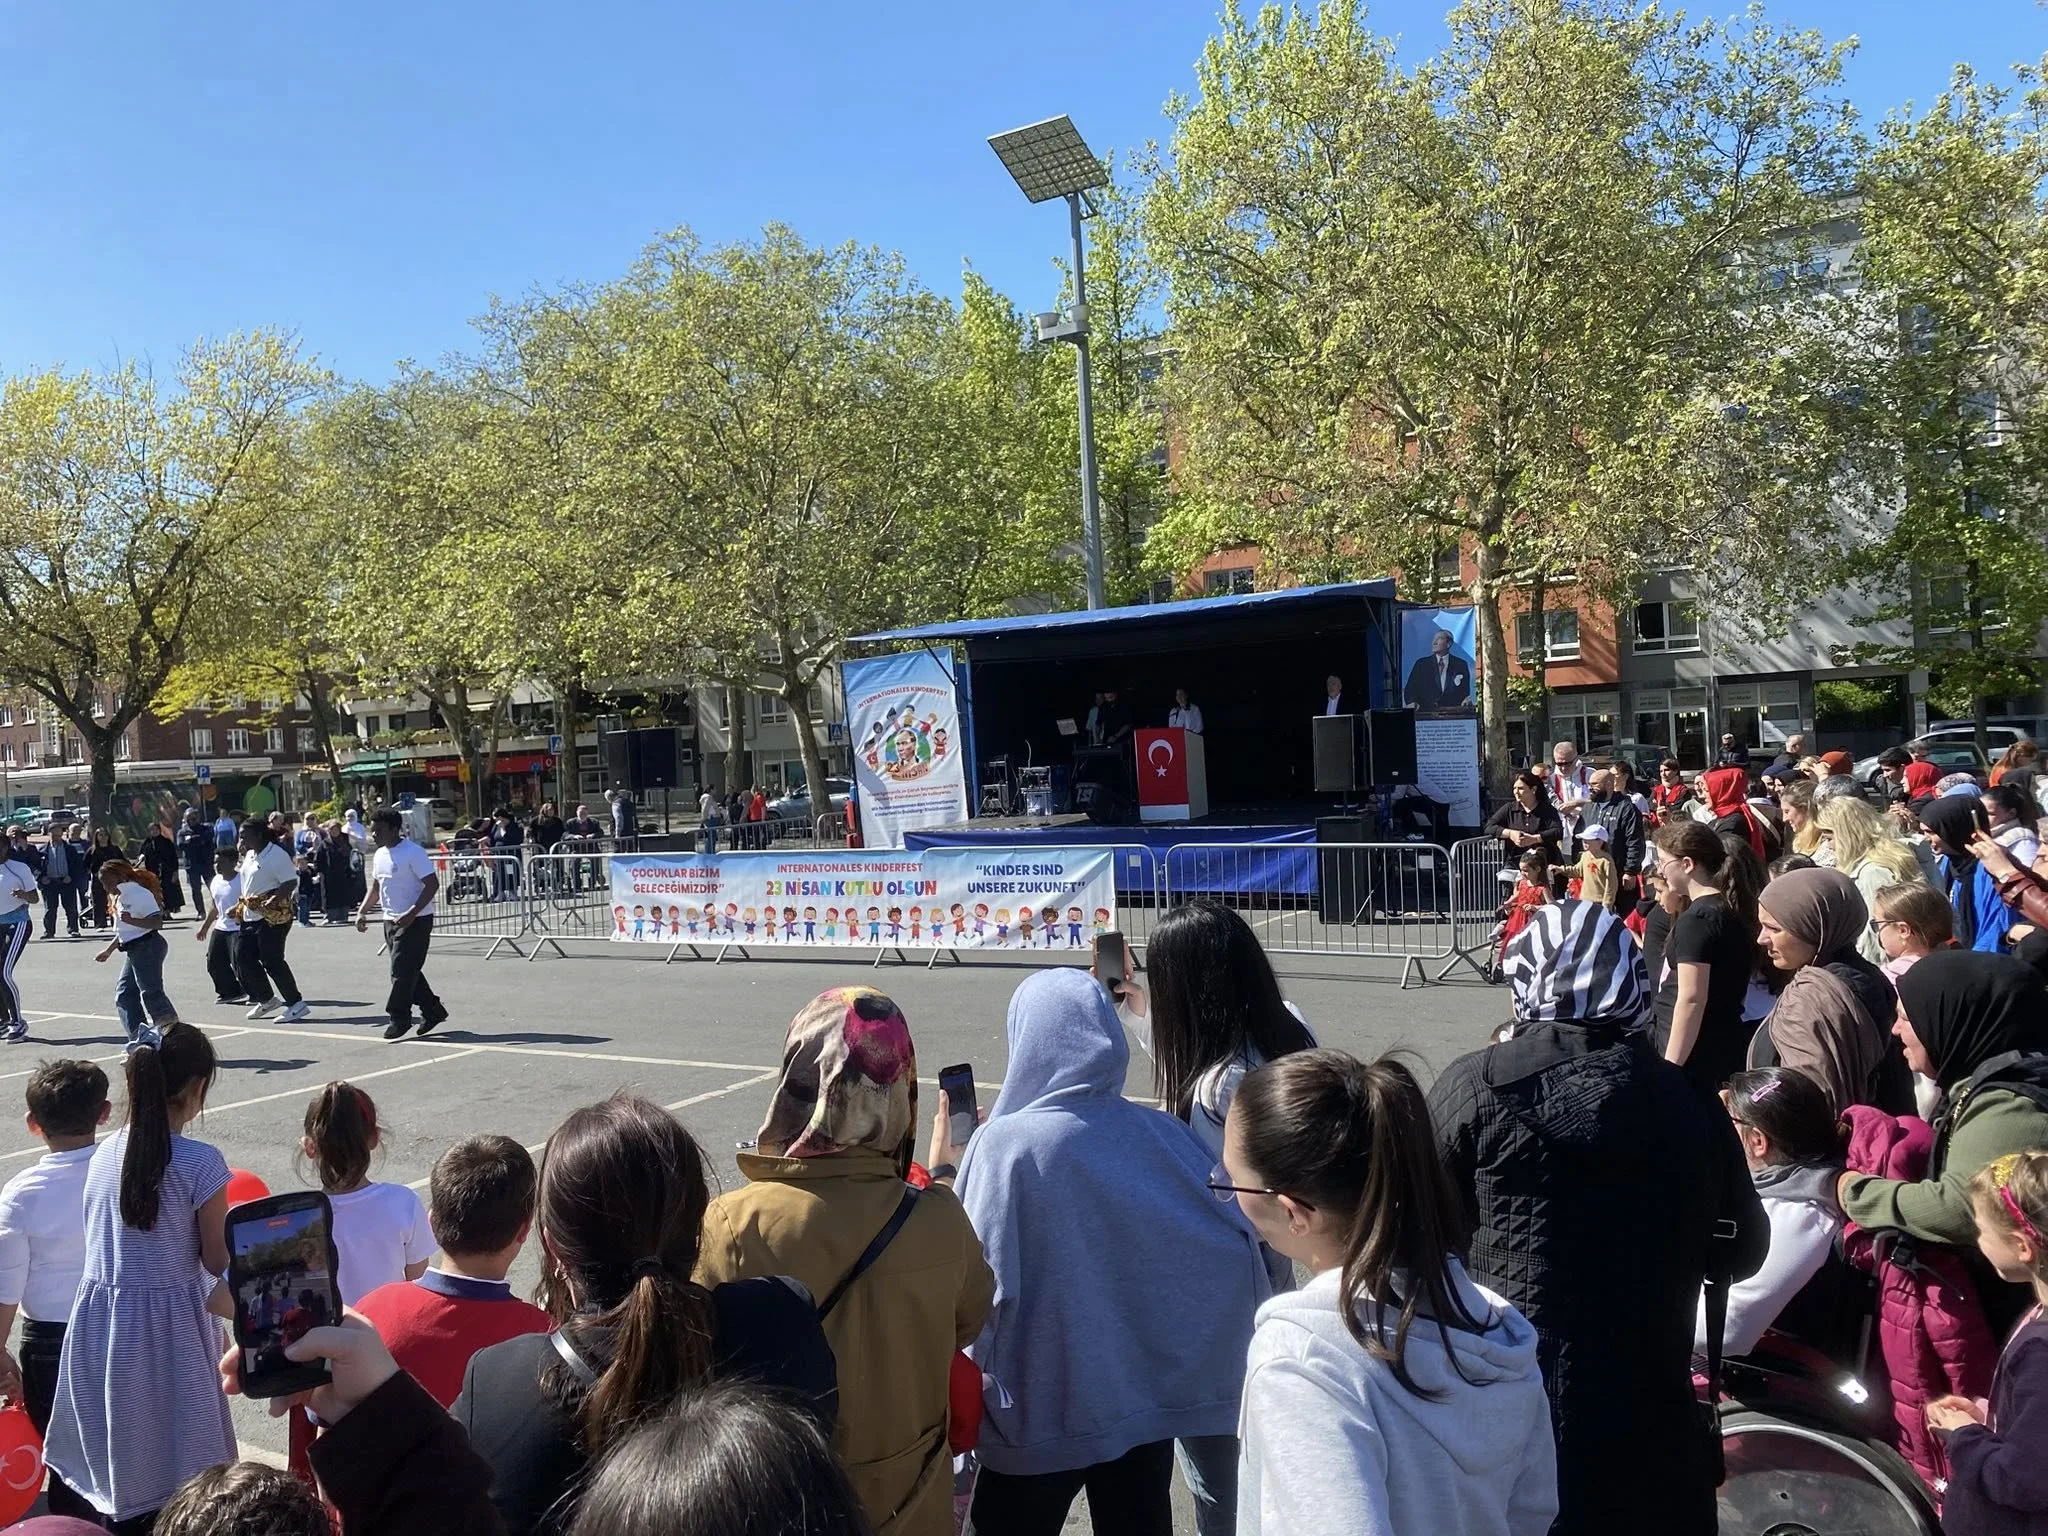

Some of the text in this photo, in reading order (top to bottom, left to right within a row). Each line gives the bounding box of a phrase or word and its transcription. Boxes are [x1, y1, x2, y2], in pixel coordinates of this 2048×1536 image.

[910, 686, 948, 697] KINDERFEST
[689, 866, 720, 879] BİZİM
[777, 862, 923, 873] INTERNATONALES KINDERFEST
[1032, 864, 1064, 876] SIND
[766, 877, 937, 897] 23 NİSAN KUTLU OLSUN
[967, 882, 1016, 894] UNSERE
